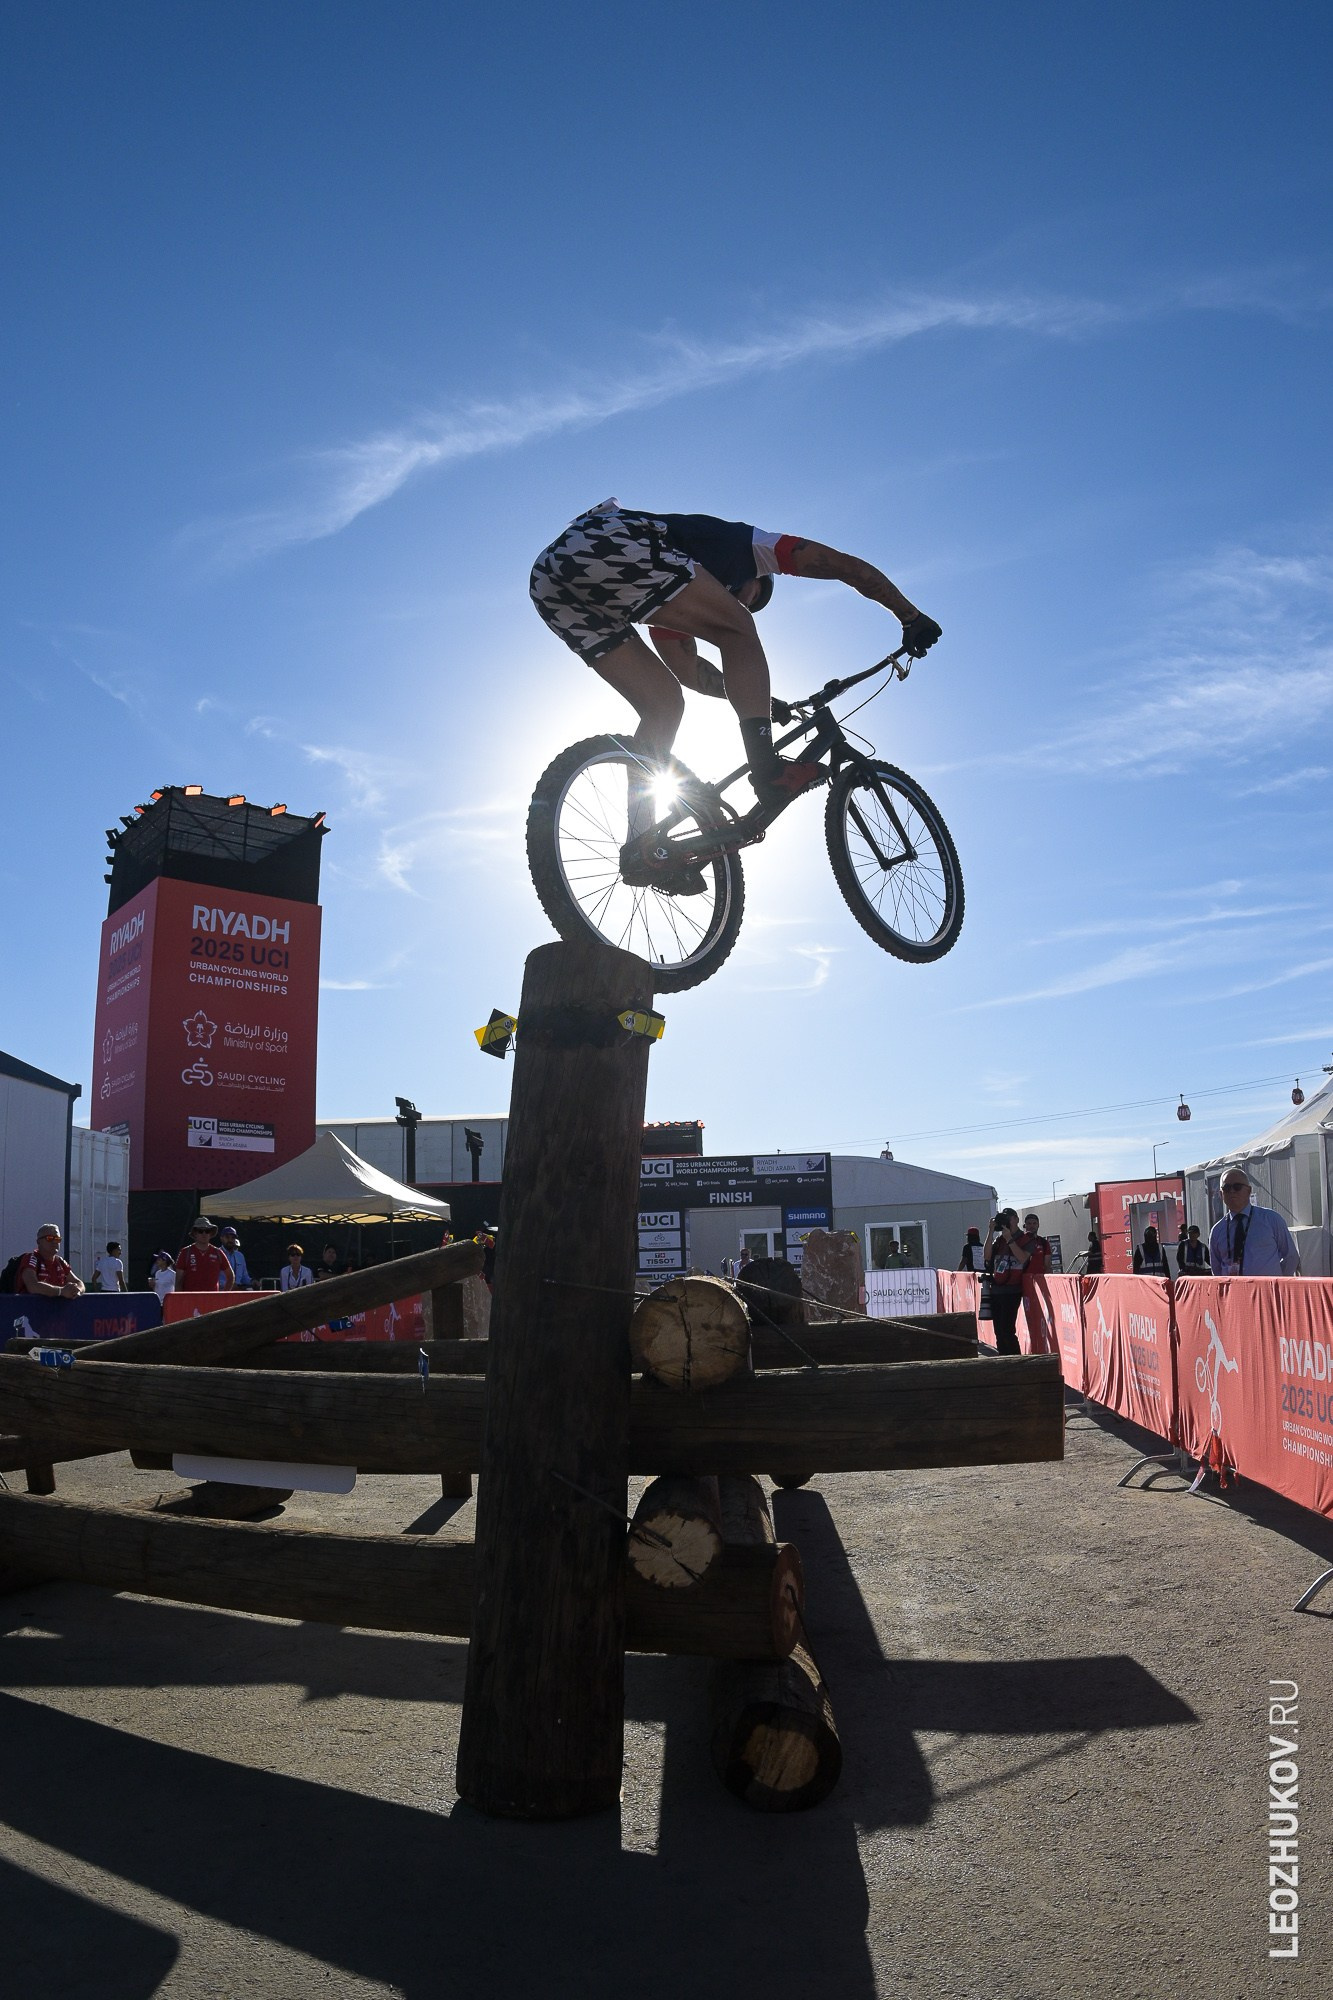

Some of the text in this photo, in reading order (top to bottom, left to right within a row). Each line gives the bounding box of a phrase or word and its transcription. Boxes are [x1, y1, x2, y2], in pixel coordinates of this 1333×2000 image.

[192, 904, 290, 944] RIYADH
[110, 909, 145, 957] RIYADH
[190, 936, 289, 969] 2025 UCI
[189, 961, 289, 982] URBAN CYCLING WORLD
[189, 973, 288, 995] CHAMPIONSHIPS
[224, 1022, 288, 1042] وزارة الرياضة
[223, 1037, 288, 1053] Ministry of Sport
[217, 1071, 286, 1086] SAUDI CYCLING
[193, 1120, 215, 1131] UCI
[236, 1128, 273, 1136] CHAMPIONSHIPS
[642, 1163, 670, 1175] UCI
[699, 1166, 749, 1174] CHAMPIONSHIPS
[710, 1191, 753, 1204] FINISH
[647, 1215, 674, 1226] UCI
[788, 1212, 826, 1220] SHIMANO
[1052, 1246, 1058, 1255] 2
[873, 1287, 930, 1296] SAUDI CYCLING
[1128, 1312, 1157, 1344] RIYADH
[1281, 1384, 1314, 1419] 2025
[1282, 1420, 1300, 1436] URBAN
[1300, 1425, 1323, 1443] CYCLING
